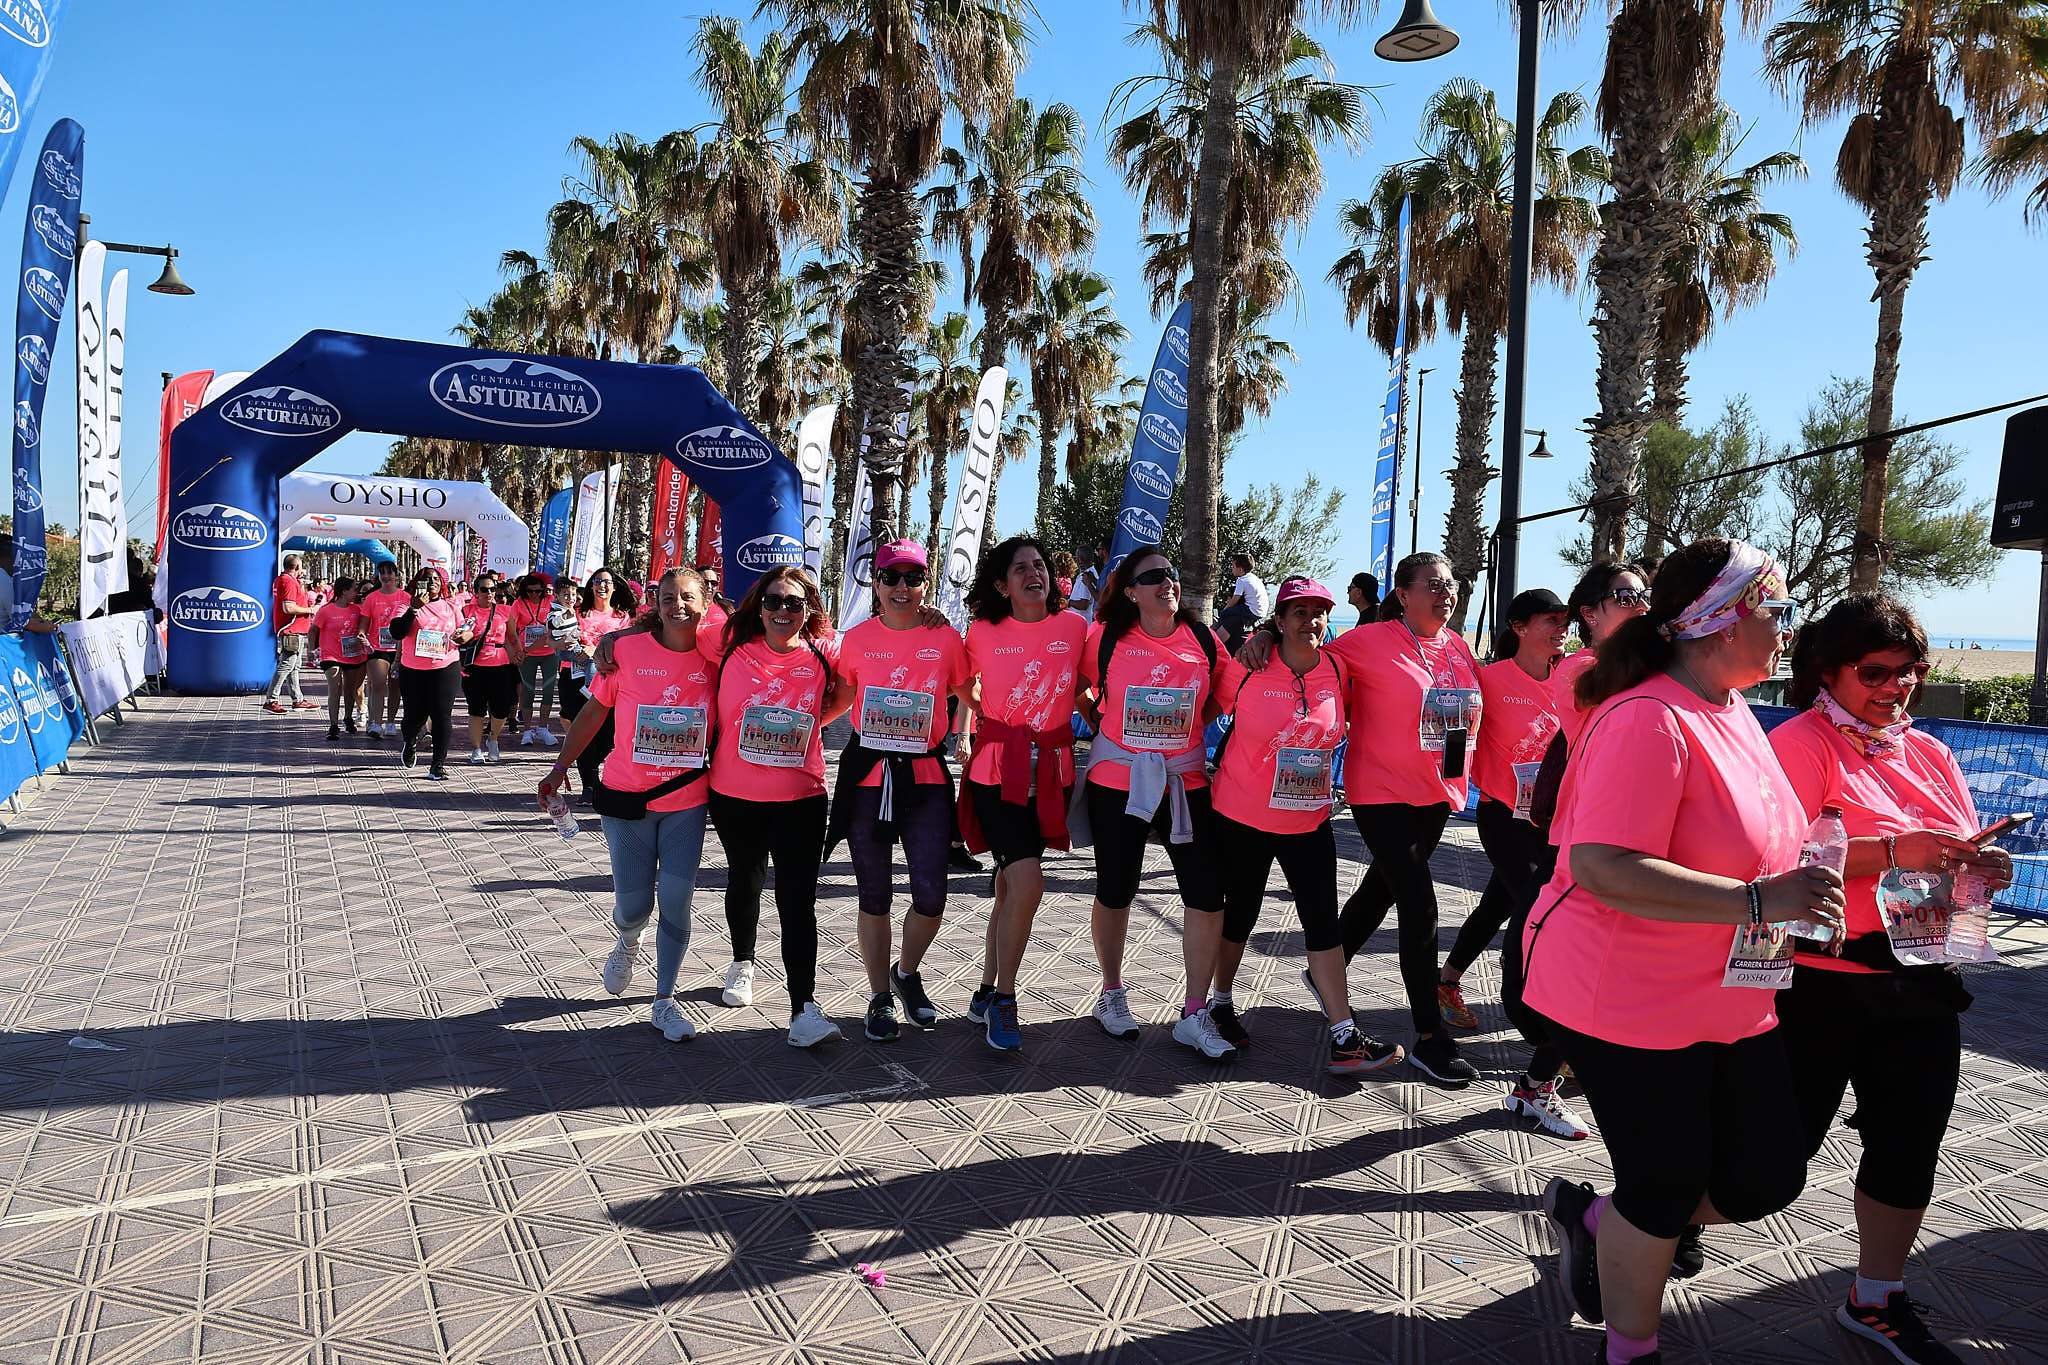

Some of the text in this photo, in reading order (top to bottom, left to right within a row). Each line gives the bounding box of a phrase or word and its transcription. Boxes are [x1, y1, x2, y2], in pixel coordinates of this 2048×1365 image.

[471, 374, 584, 392] CENTRAL LECHERA
[443, 373, 589, 415] ASTURIANA
[248, 400, 331, 413] CENTRAL LECHERA
[227, 401, 332, 427] ASTURIANA
[1144, 418, 1180, 450] ASTURIANA
[684, 441, 767, 460] ASTURIANA
[1134, 466, 1170, 496] ASTURIANA
[330, 482, 447, 509] OYSHO
[665, 468, 682, 537] Santander
[478, 513, 511, 521] OYSHO
[176, 519, 261, 541] ASTURIANA
[494, 556, 525, 565] OYSHO
[174, 602, 258, 622] ASTURIANA
[864, 651, 894, 659] OYSHO
[995, 647, 1024, 655] OYSHO
[637, 668, 668, 677] OYSHO
[1263, 690, 1294, 699] OYSHO
[884, 716, 910, 728] 016
[1146, 714, 1172, 726] 016
[658, 733, 685, 744] 016
[763, 732, 790, 744] 016
[1916, 938, 1924, 946] DE
[1734, 960, 1762, 969] CARRERA
[1763, 961, 1771, 969] DE
[1737, 973, 1771, 983] OYSHO
